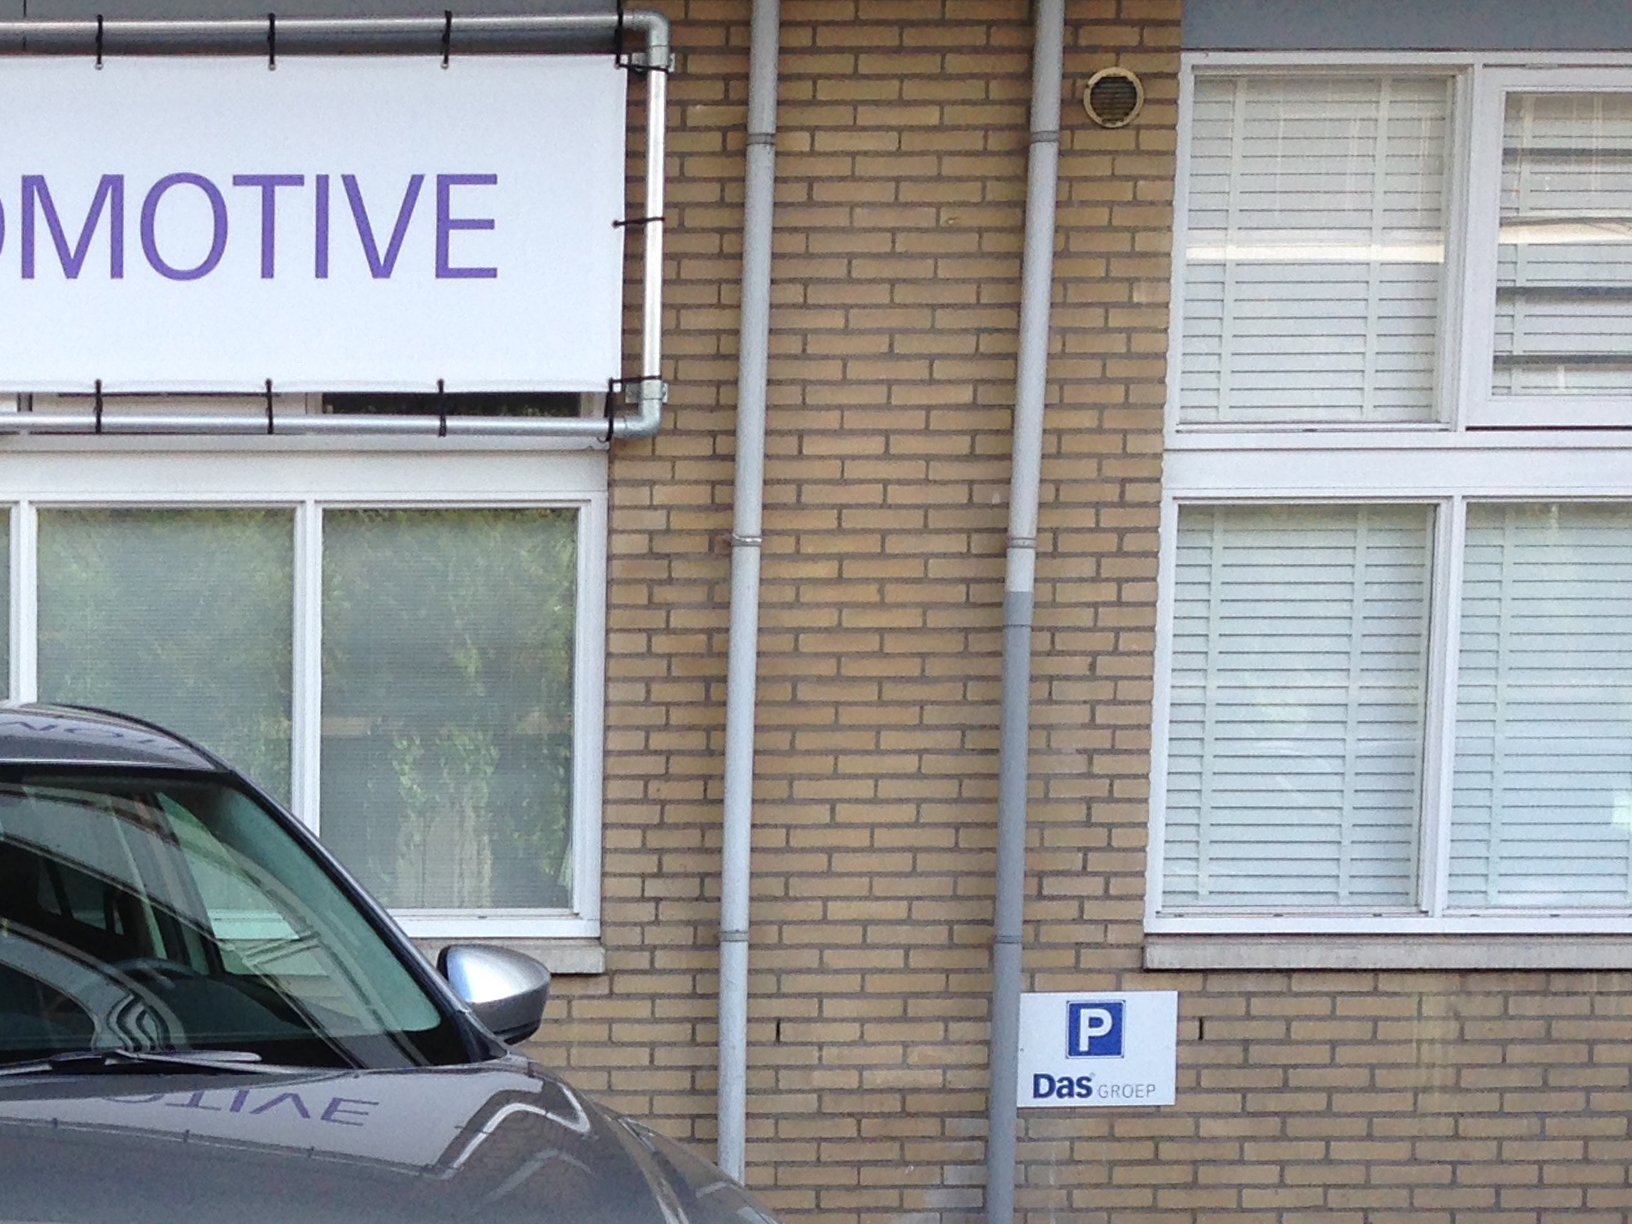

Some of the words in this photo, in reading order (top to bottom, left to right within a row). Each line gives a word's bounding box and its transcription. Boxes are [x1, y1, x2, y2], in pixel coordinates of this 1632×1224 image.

[1079, 1008, 1114, 1053] P
[1032, 1073, 1094, 1100] Das
[1097, 1084, 1157, 1100] GROEP
